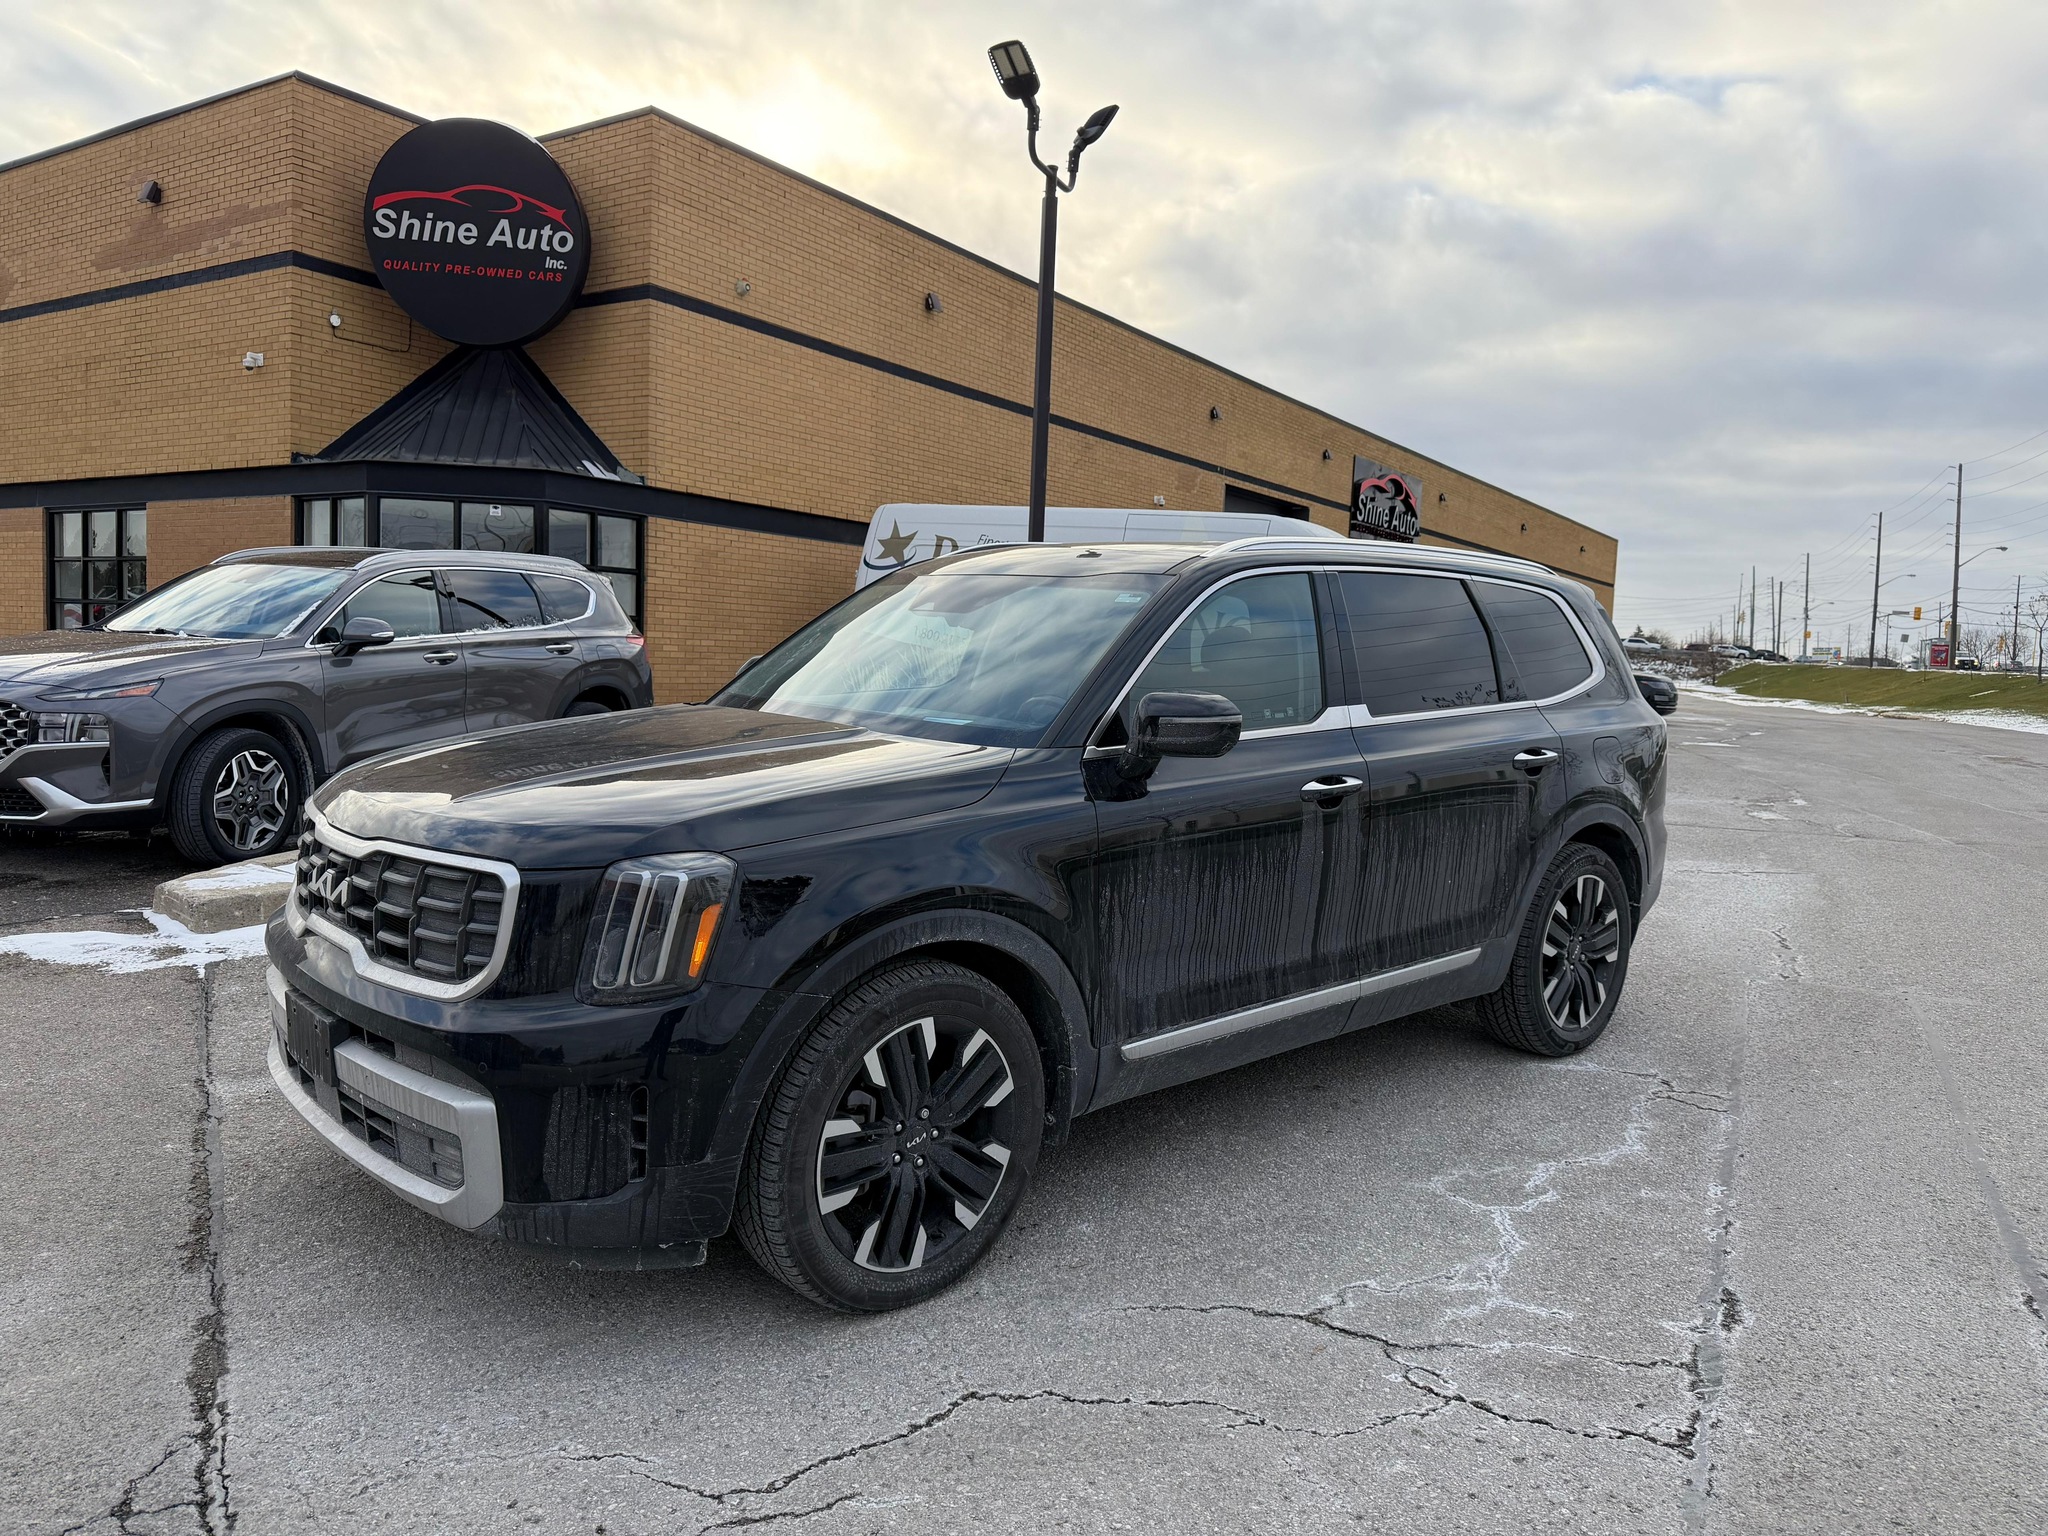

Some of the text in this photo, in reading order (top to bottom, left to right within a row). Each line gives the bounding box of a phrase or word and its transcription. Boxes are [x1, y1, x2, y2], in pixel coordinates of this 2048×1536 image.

[372, 208, 574, 253] Shine Auto
[383, 259, 563, 282] QUALITY PRE-OWNED CARS
[545, 256, 568, 270] Inc.
[1357, 494, 1390, 528] Shine
[1391, 506, 1416, 536] Auto
[307, 864, 351, 908] KIA
